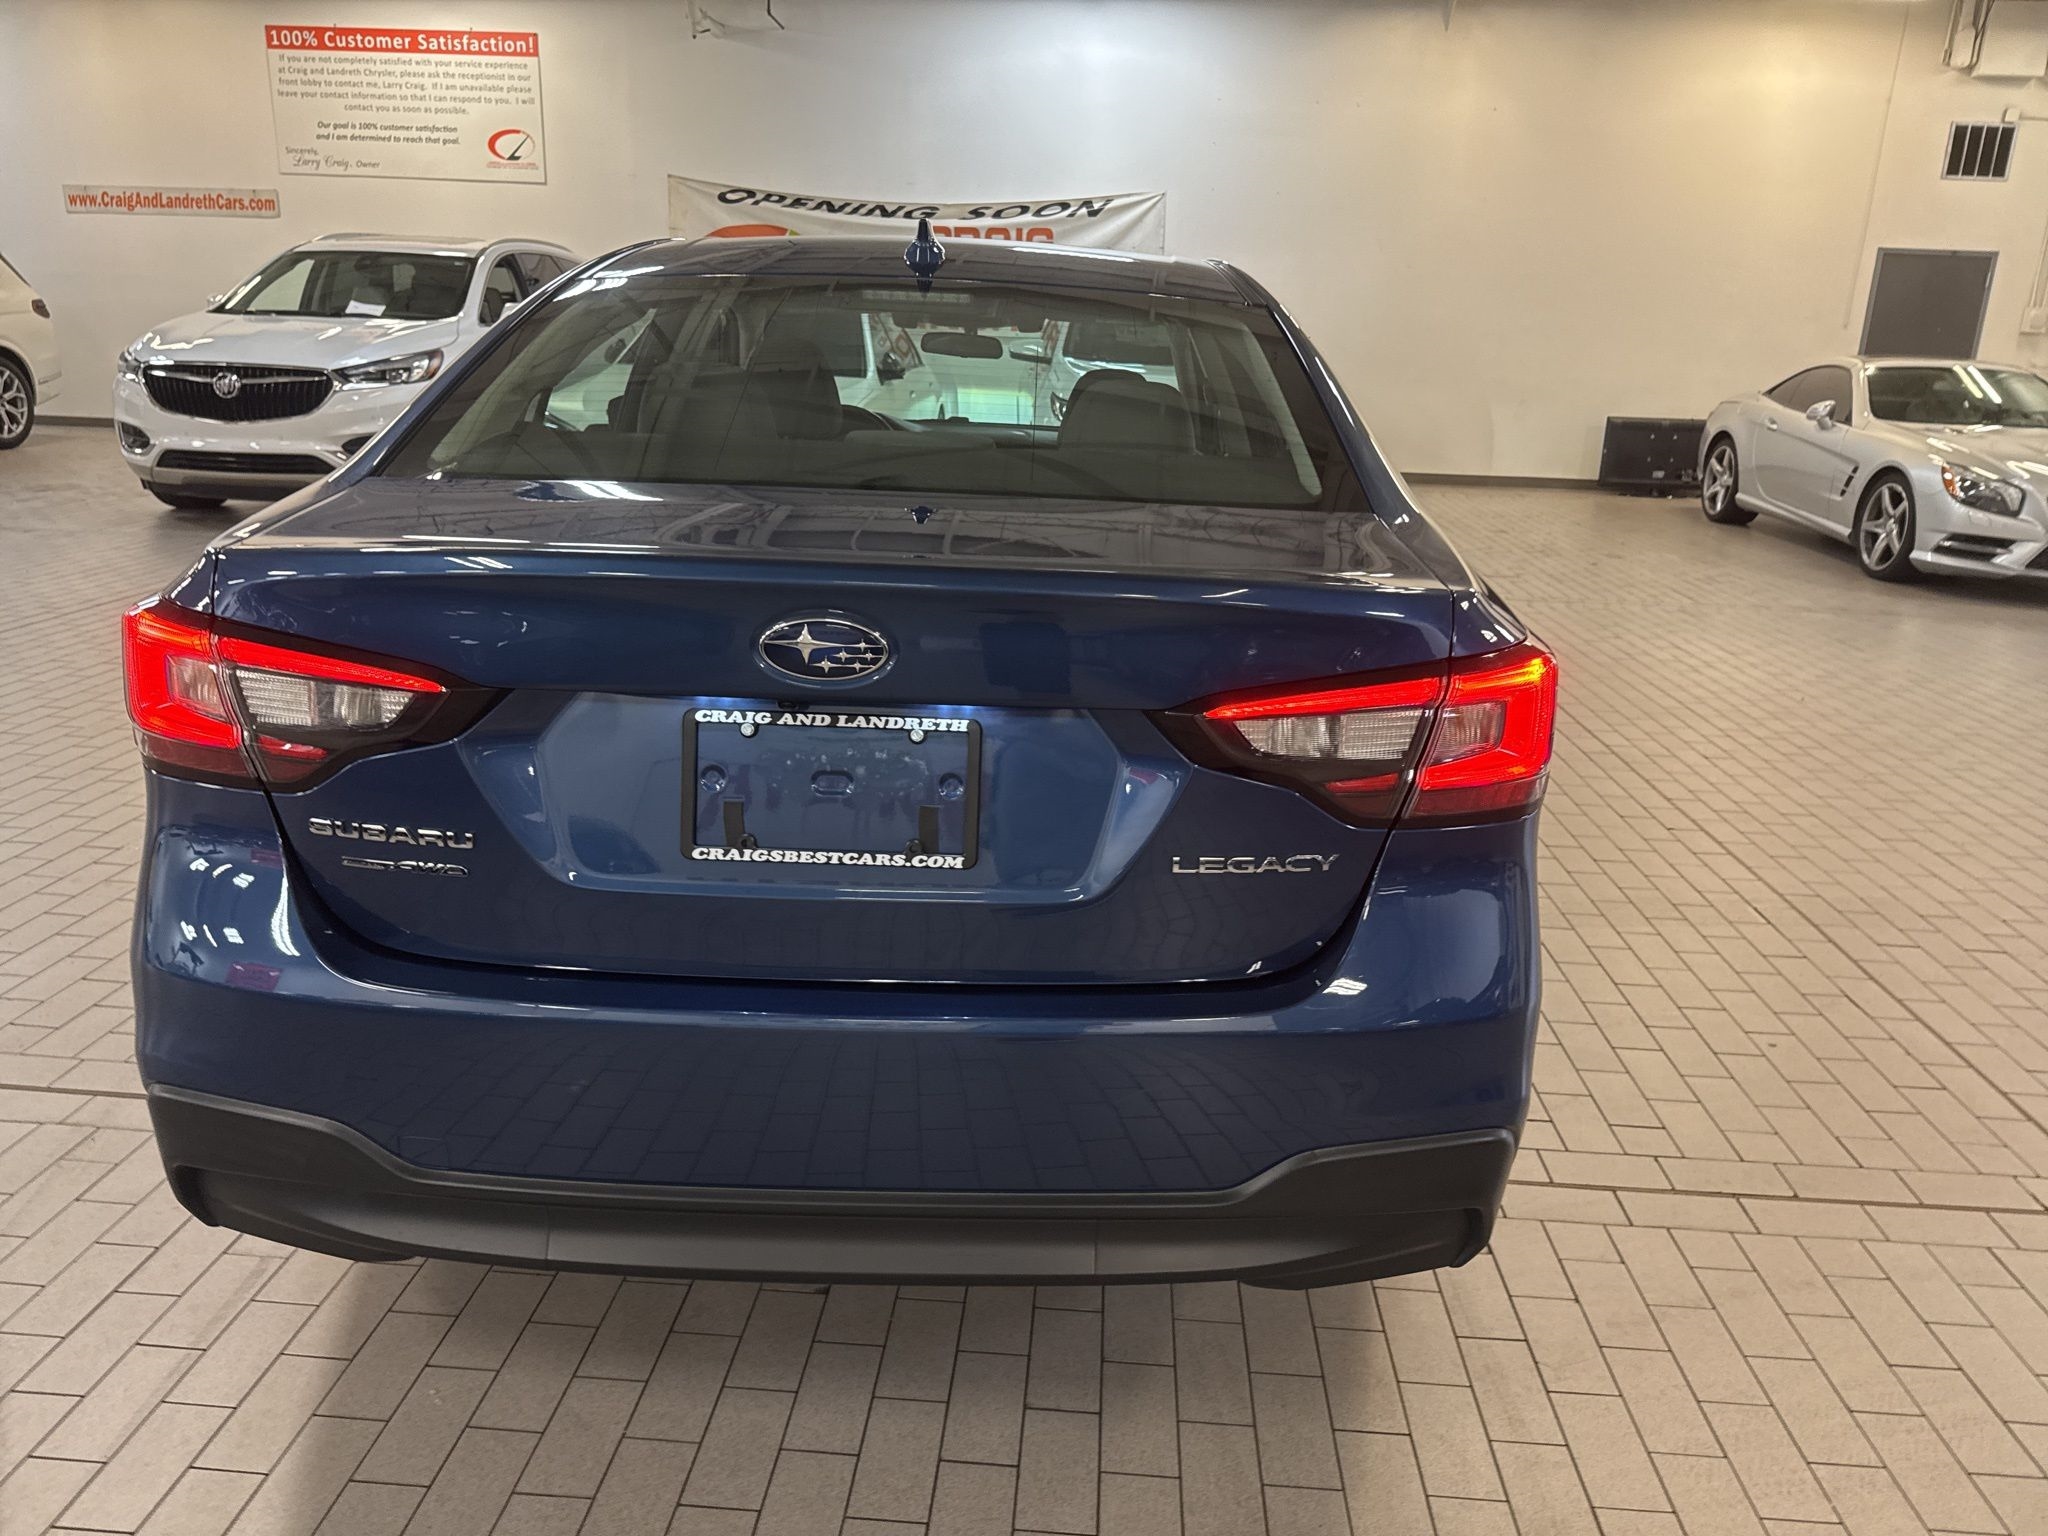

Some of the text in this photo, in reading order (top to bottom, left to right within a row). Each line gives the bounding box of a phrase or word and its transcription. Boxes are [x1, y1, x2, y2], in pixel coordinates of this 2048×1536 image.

[270, 29, 534, 53] 100% Customer Satisfaction!
[286, 56, 302, 64] you
[334, 56, 376, 66] completely
[379, 56, 412, 66] satisfied
[414, 58, 432, 66] with
[434, 60, 452, 68] your
[454, 60, 482, 68] service
[484, 60, 528, 70] experience
[288, 66, 308, 76] Craig
[310, 66, 324, 75] and
[326, 67, 362, 76] Landreth
[400, 70, 425, 78] please
[427, 70, 440, 78] ask
[442, 71, 456, 79] the
[458, 72, 506, 82] receptionist
[507, 72, 516, 80] in
[278, 78, 298, 86] front
[300, 78, 322, 88] lobby
[324, 79, 333, 87] to
[334, 80, 364, 88] contact
[382, 81, 402, 90] Larry
[460, 84, 504, 92] unavailable
[506, 85, 532, 94] please
[277, 89, 298, 98] leave
[300, 92, 318, 100] your
[350, 91, 398, 101] information
[450, 96, 482, 104] respond
[344, 103, 374, 112] contact
[375, 105, 390, 113] you
[317, 121, 458, 134] Our goal is 100% customer satisfaction
[316, 132, 330, 140] and
[350, 133, 392, 142] determined
[393, 134, 402, 142] to
[424, 136, 440, 144] that
[356, 160, 380, 168] Owner
[67, 190, 276, 212] www.CraigAndLandrethCars.com
[717, 188, 1114, 220] OPENING SOON
[694, 710, 970, 732] CRAIG AND LANDRETH
[308, 816, 475, 850] SUBARU
[691, 848, 964, 869] CRAIGSBESTCARS.COM
[1172, 854, 1341, 874] LEGACY
